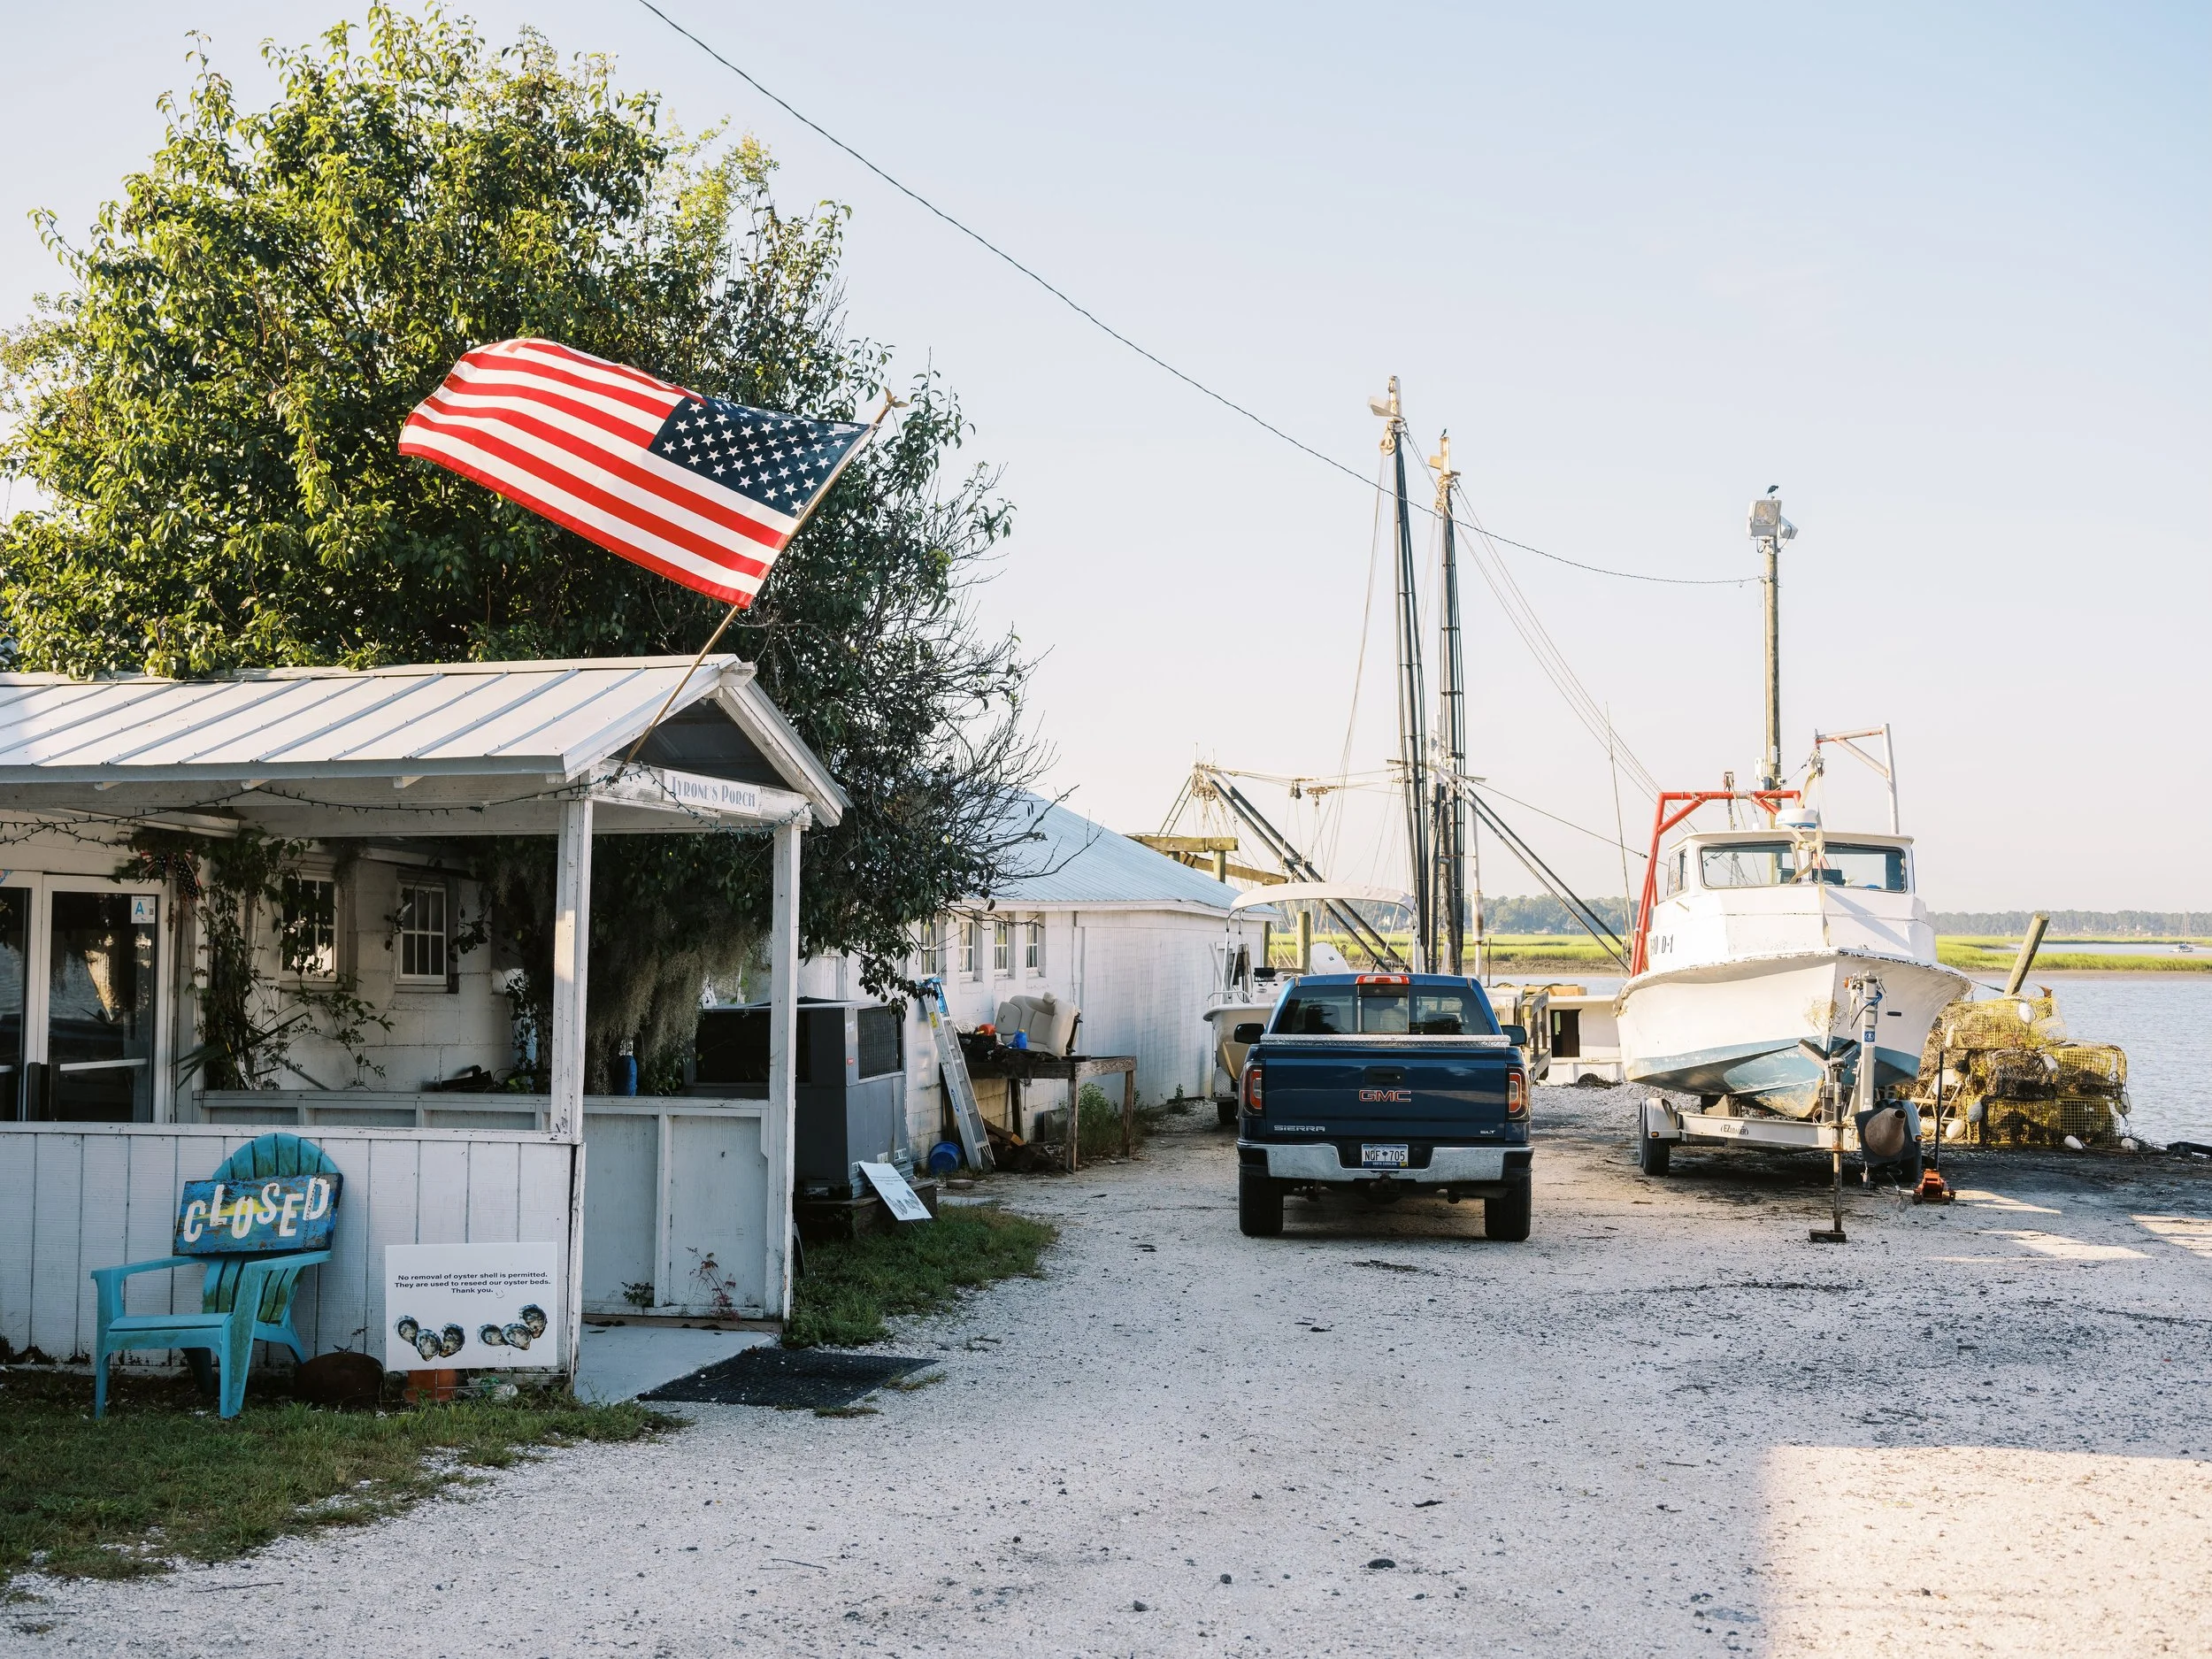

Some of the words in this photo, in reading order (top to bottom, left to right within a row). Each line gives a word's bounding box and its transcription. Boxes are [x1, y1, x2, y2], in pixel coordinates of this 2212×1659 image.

[672, 776, 718, 802] TYRONE'S
[721, 785, 756, 807] PORCH
[134, 901, 144, 915] A
[1359, 1089, 1411, 1102] GMC
[1389, 1150, 1405, 1162] 705
[183, 1178, 331, 1242] CLOSED
